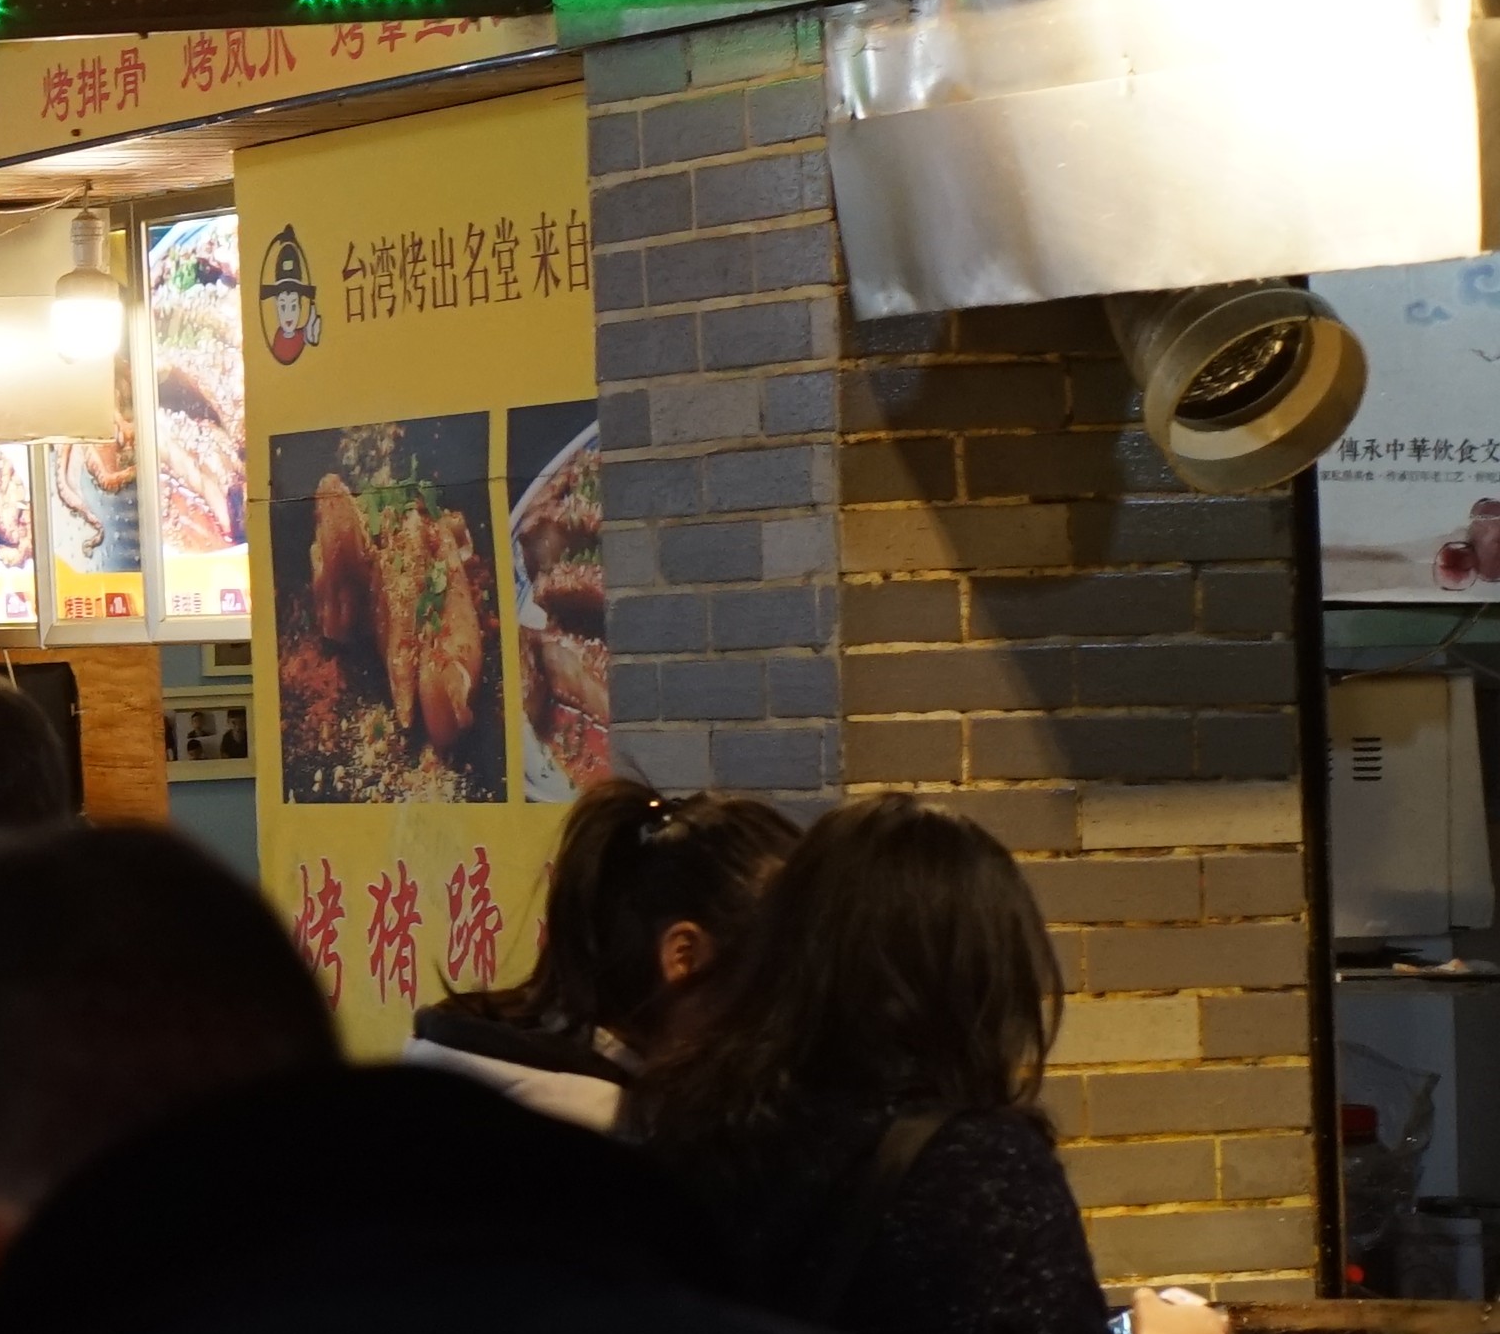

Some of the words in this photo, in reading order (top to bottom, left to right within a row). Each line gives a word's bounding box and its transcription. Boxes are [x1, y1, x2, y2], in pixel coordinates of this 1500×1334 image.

[41, 47, 146, 122] 烤排骨
[180, 27, 298, 92] 烤凤爪
[342, 215, 523, 324] 台湾烤出名堂
[530, 208, 592, 300] 来自
[293, 845, 504, 1013] 烤猪蹄
